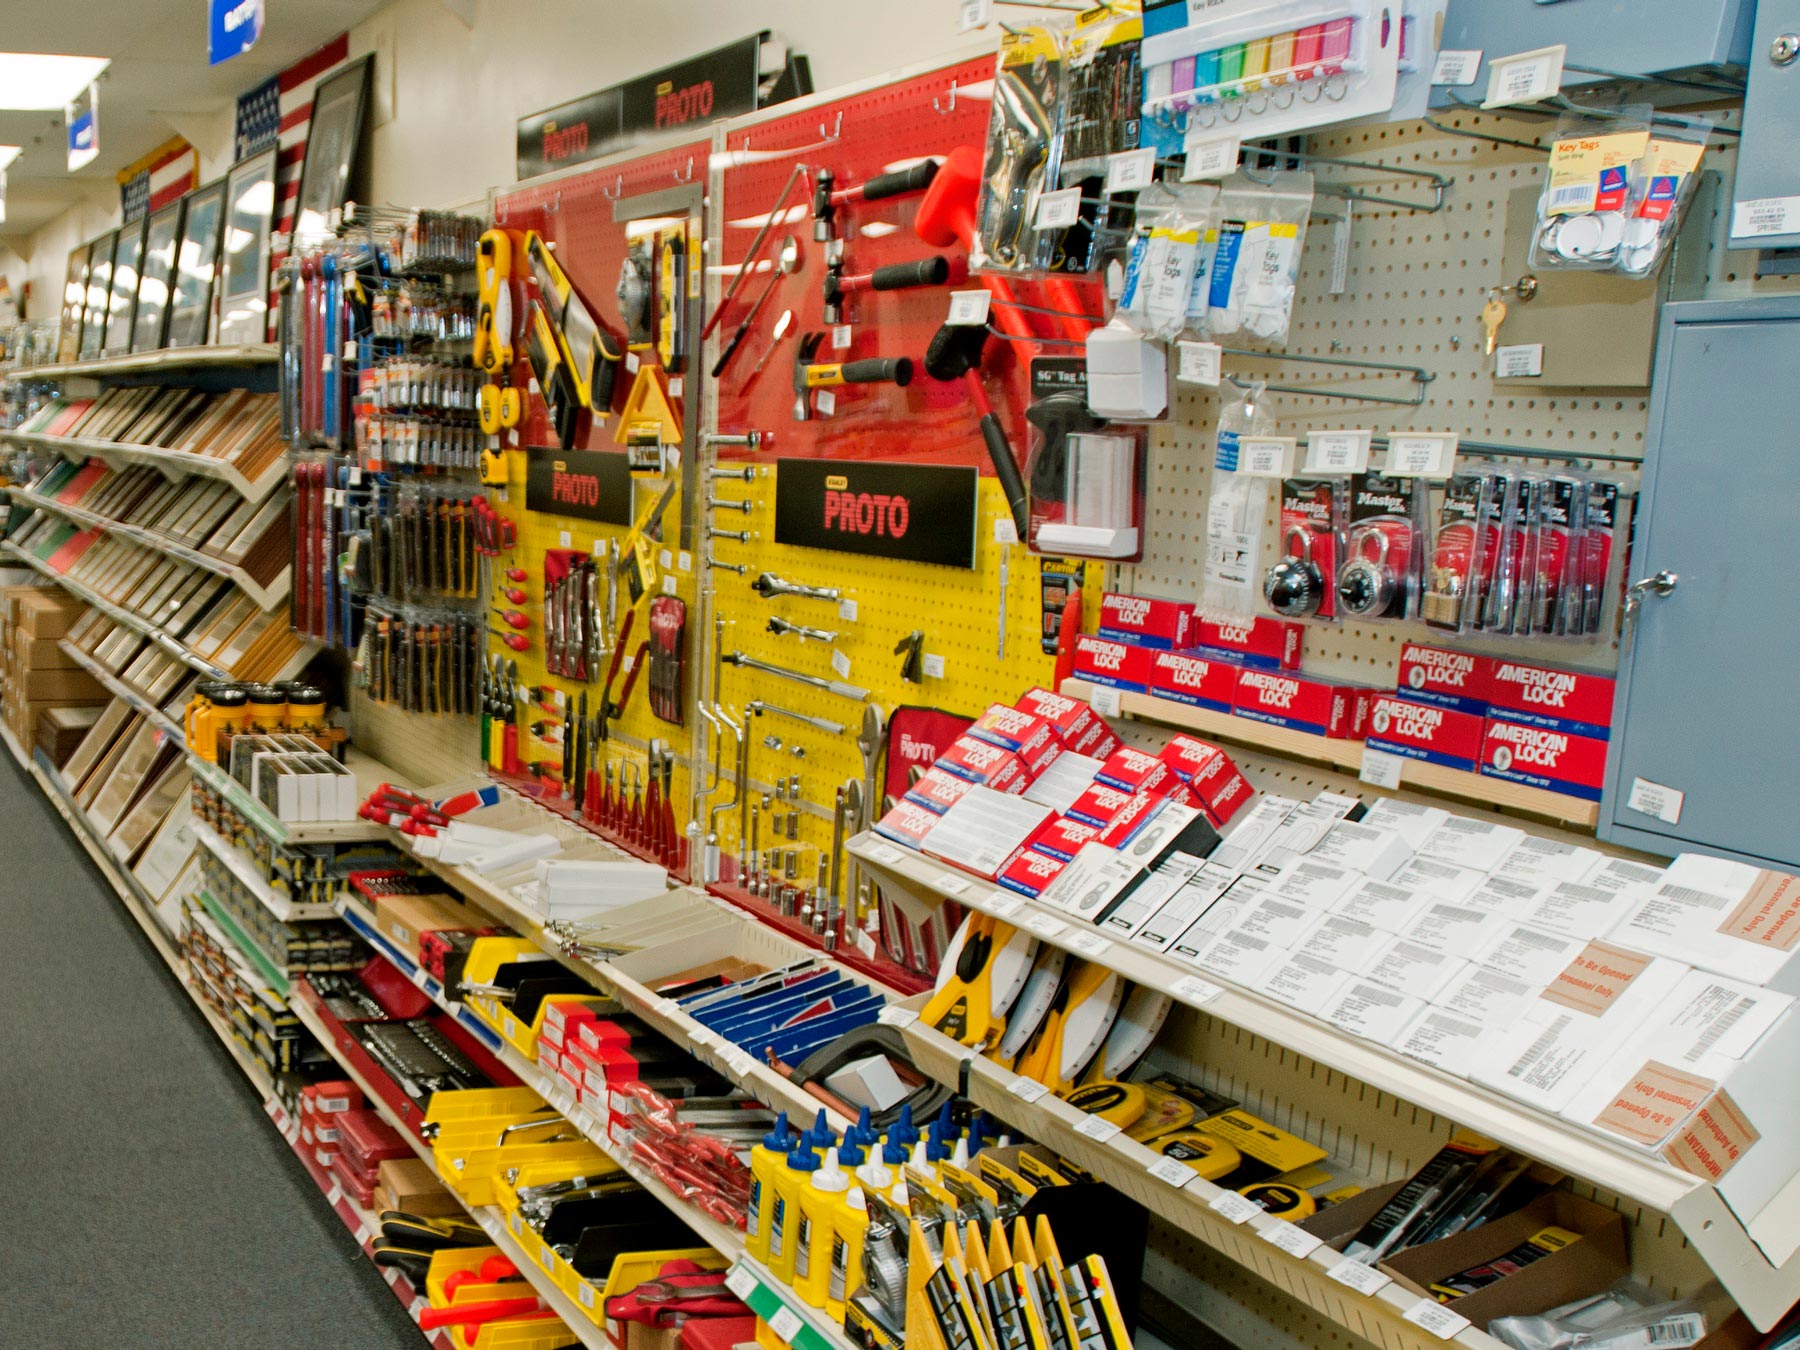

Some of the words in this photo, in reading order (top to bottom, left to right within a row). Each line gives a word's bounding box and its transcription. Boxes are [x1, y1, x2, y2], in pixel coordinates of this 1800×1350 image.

[655, 80, 714, 129] PROTO
[542, 122, 588, 163] PROTO
[1559, 143, 1576, 153] Key
[1579, 141, 1599, 150] Tags
[1167, 256, 1181, 270] Key
[1265, 252, 1280, 262] Key
[1164, 266, 1181, 278] Tags
[1262, 263, 1280, 274] Tags
[1057, 371, 1077, 383] Tag
[553, 471, 598, 507] PROTO
[1358, 491, 1403, 506] Master
[824, 490, 909, 538] PROTO
[1284, 497, 1328, 513] Master
[1103, 595, 1150, 613] AMERICAN
[1118, 610, 1145, 625] LOCK
[1219, 626, 1249, 643] LOCK
[1078, 638, 1127, 659] AMERICAN
[1093, 653, 1121, 671] LOCK
[1157, 653, 1208, 676] AMERICAN
[1403, 646, 1475, 672] AMERICAN
[1173, 670, 1202, 688] LOCK
[1240, 671, 1299, 695] AMERICAN
[1427, 666, 1465, 686] LOCK
[1496, 664, 1576, 692] AMERICAN
[1026, 688, 1077, 712] AMERICAN
[1259, 689, 1291, 708] LOCK
[1522, 685, 1565, 708] LOCK
[987, 704, 1036, 727] AMERICAN
[1034, 703, 1066, 720] LOCK
[1373, 699, 1443, 727] AMERICAN
[995, 718, 1025, 735] LOCK
[1396, 719, 1434, 741] LOCK
[1172, 736, 1217, 756] AMERICAN
[1488, 723, 1568, 752] AMERICAN
[955, 737, 1005, 762] AMERICAN
[1116, 748, 1160, 768] AMERICAN
[1179, 748, 1208, 763] LOCK
[1514, 744, 1557, 768] LOCK
[963, 751, 993, 769] LOCK
[1123, 759, 1151, 774] LOCK
[932, 784, 962, 802] LOCK
[1088, 784, 1132, 804] AMERICAN
[1095, 795, 1121, 809] LOCK
[1122, 796, 1151, 824] LOCK
[901, 815, 929, 835] LOCK
[1054, 818, 1099, 836] AMERICAN
[1061, 829, 1088, 843] LOCK
[1021, 850, 1064, 871] AMERICAN
[1028, 863, 1053, 878] LOCK
[1762, 909, 1796, 941] Opened
[1574, 956, 1584, 966] To
[1585, 960, 1598, 971] Be
[1598, 965, 1633, 981] Opened
[1614, 1098, 1651, 1119] Opened
[1654, 1090, 1697, 1111] Personnel
[1652, 1111, 1667, 1123] Be
[1666, 1117, 1676, 1126] To
[1697, 1108, 1731, 1149] Authorized
[1684, 1131, 1723, 1178] IMPORTANT
[1728, 1144, 1739, 1160] By
